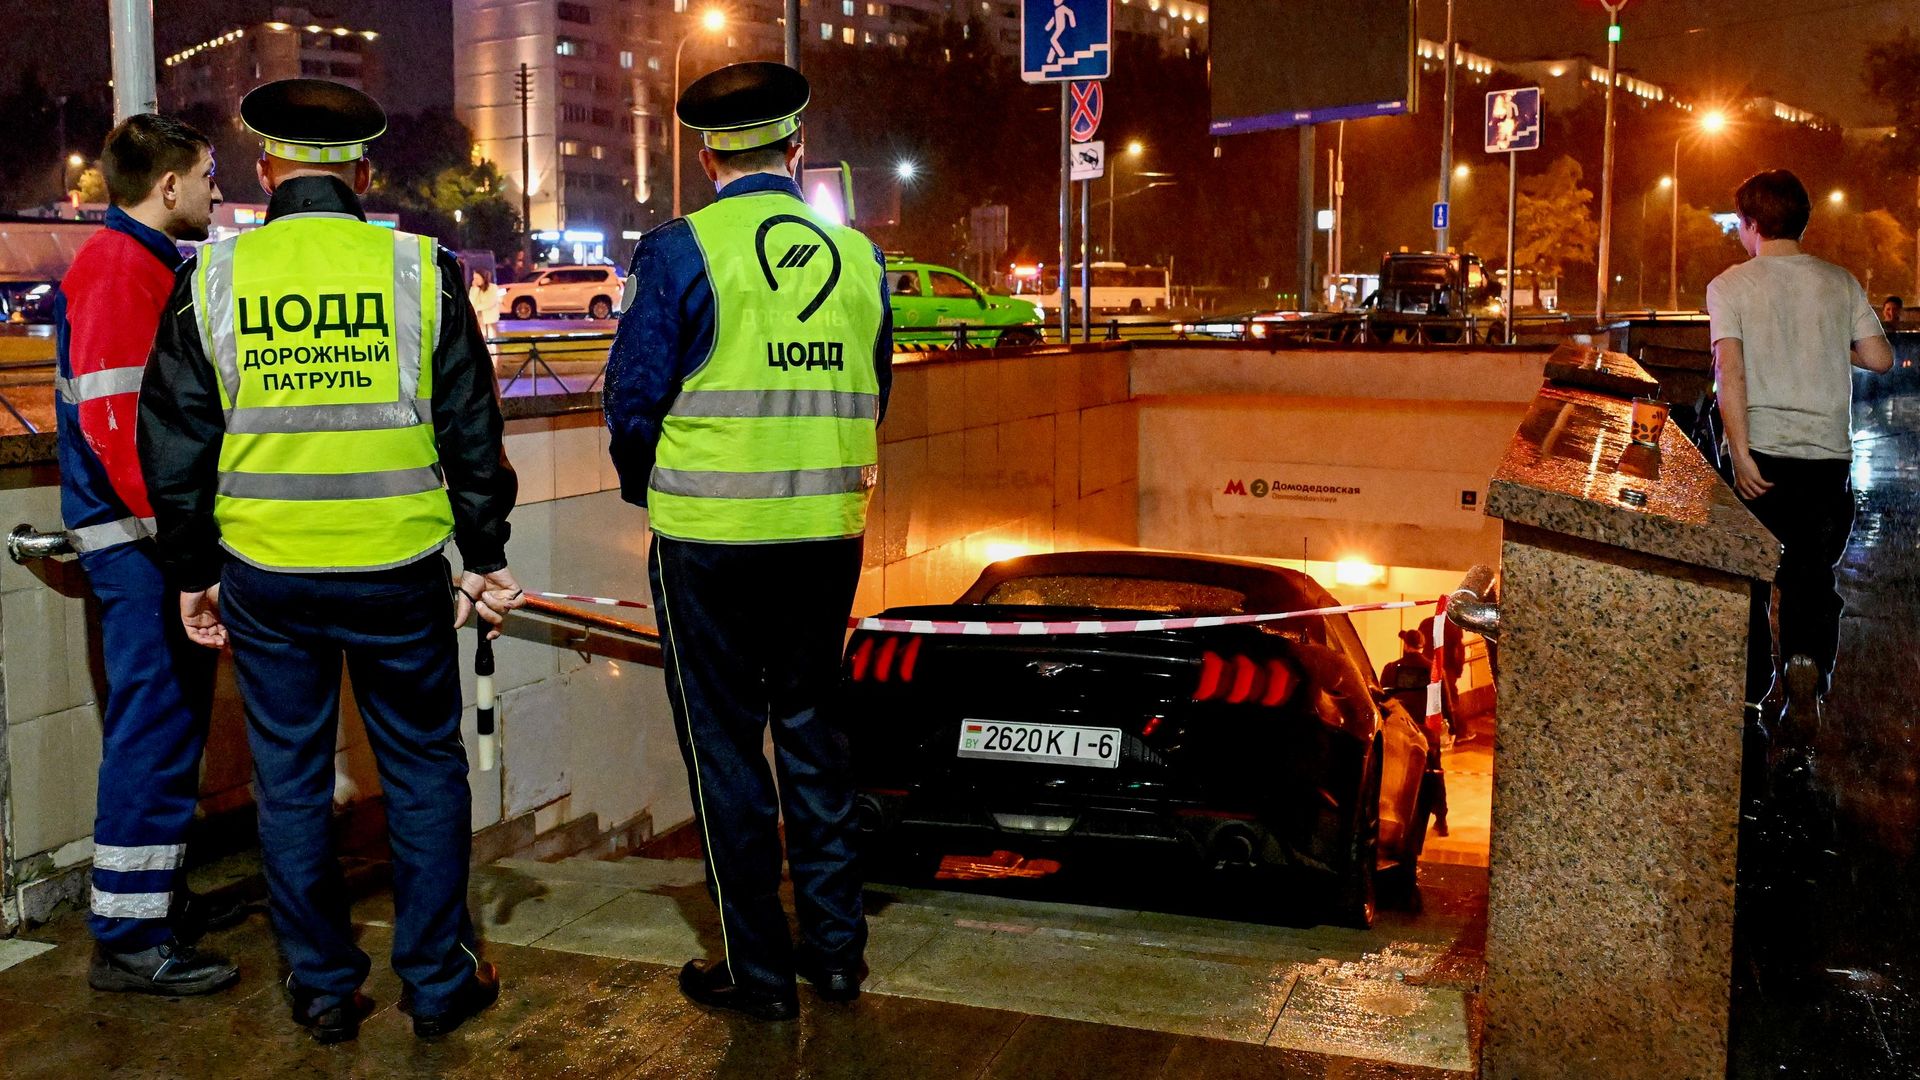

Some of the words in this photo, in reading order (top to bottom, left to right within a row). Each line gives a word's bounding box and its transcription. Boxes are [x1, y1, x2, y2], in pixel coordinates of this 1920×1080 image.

[238, 293, 390, 341] ЦОДД
[243, 341, 390, 371] ДОРОЖНЫЙ
[767, 341, 844, 371] ЦОДД
[263, 370, 373, 391] ПАТРУЛЬ
[1272, 481, 1361, 495] Домодедовская
[965, 738, 979, 749] BY
